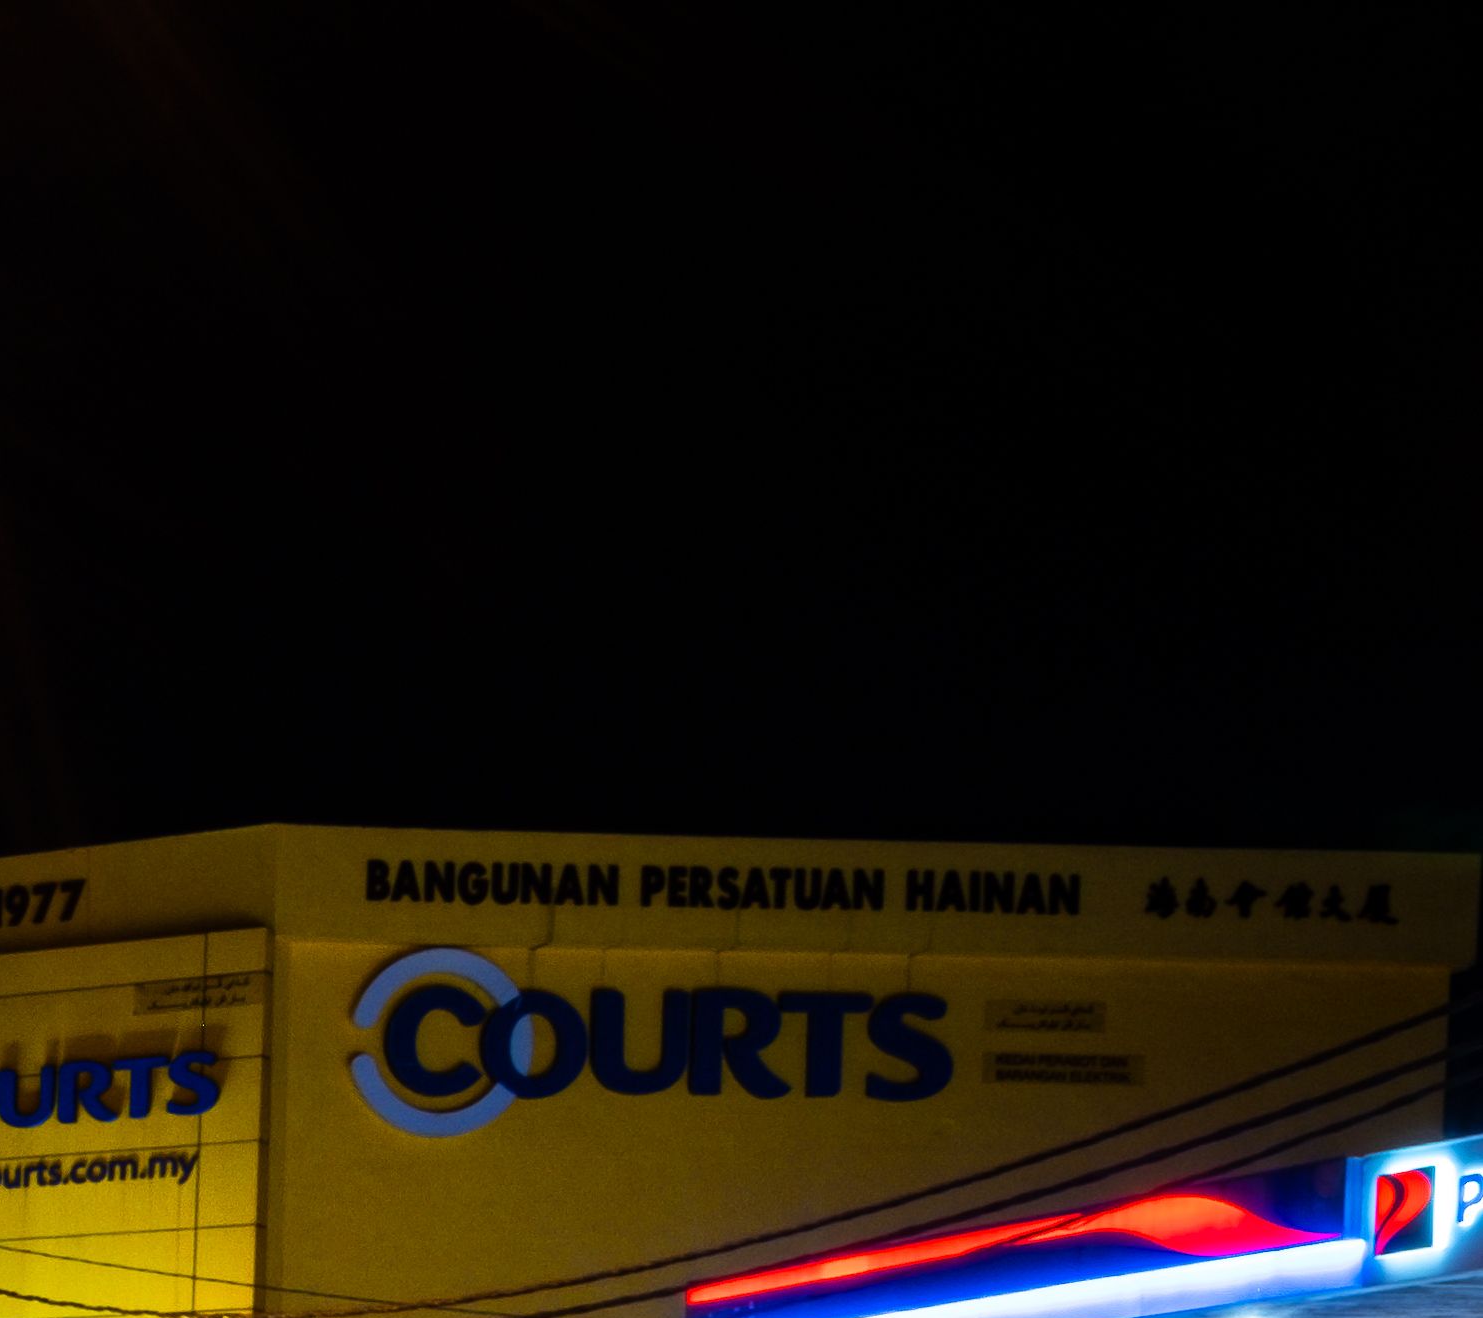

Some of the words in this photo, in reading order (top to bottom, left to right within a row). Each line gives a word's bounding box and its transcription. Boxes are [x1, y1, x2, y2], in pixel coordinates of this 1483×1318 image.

[366, 858, 620, 907] BANGUNAN
[639, 864, 886, 911] PERSATUAN
[904, 868, 1081, 916] HAINAN
[383, 985, 953, 1103] COURTS
